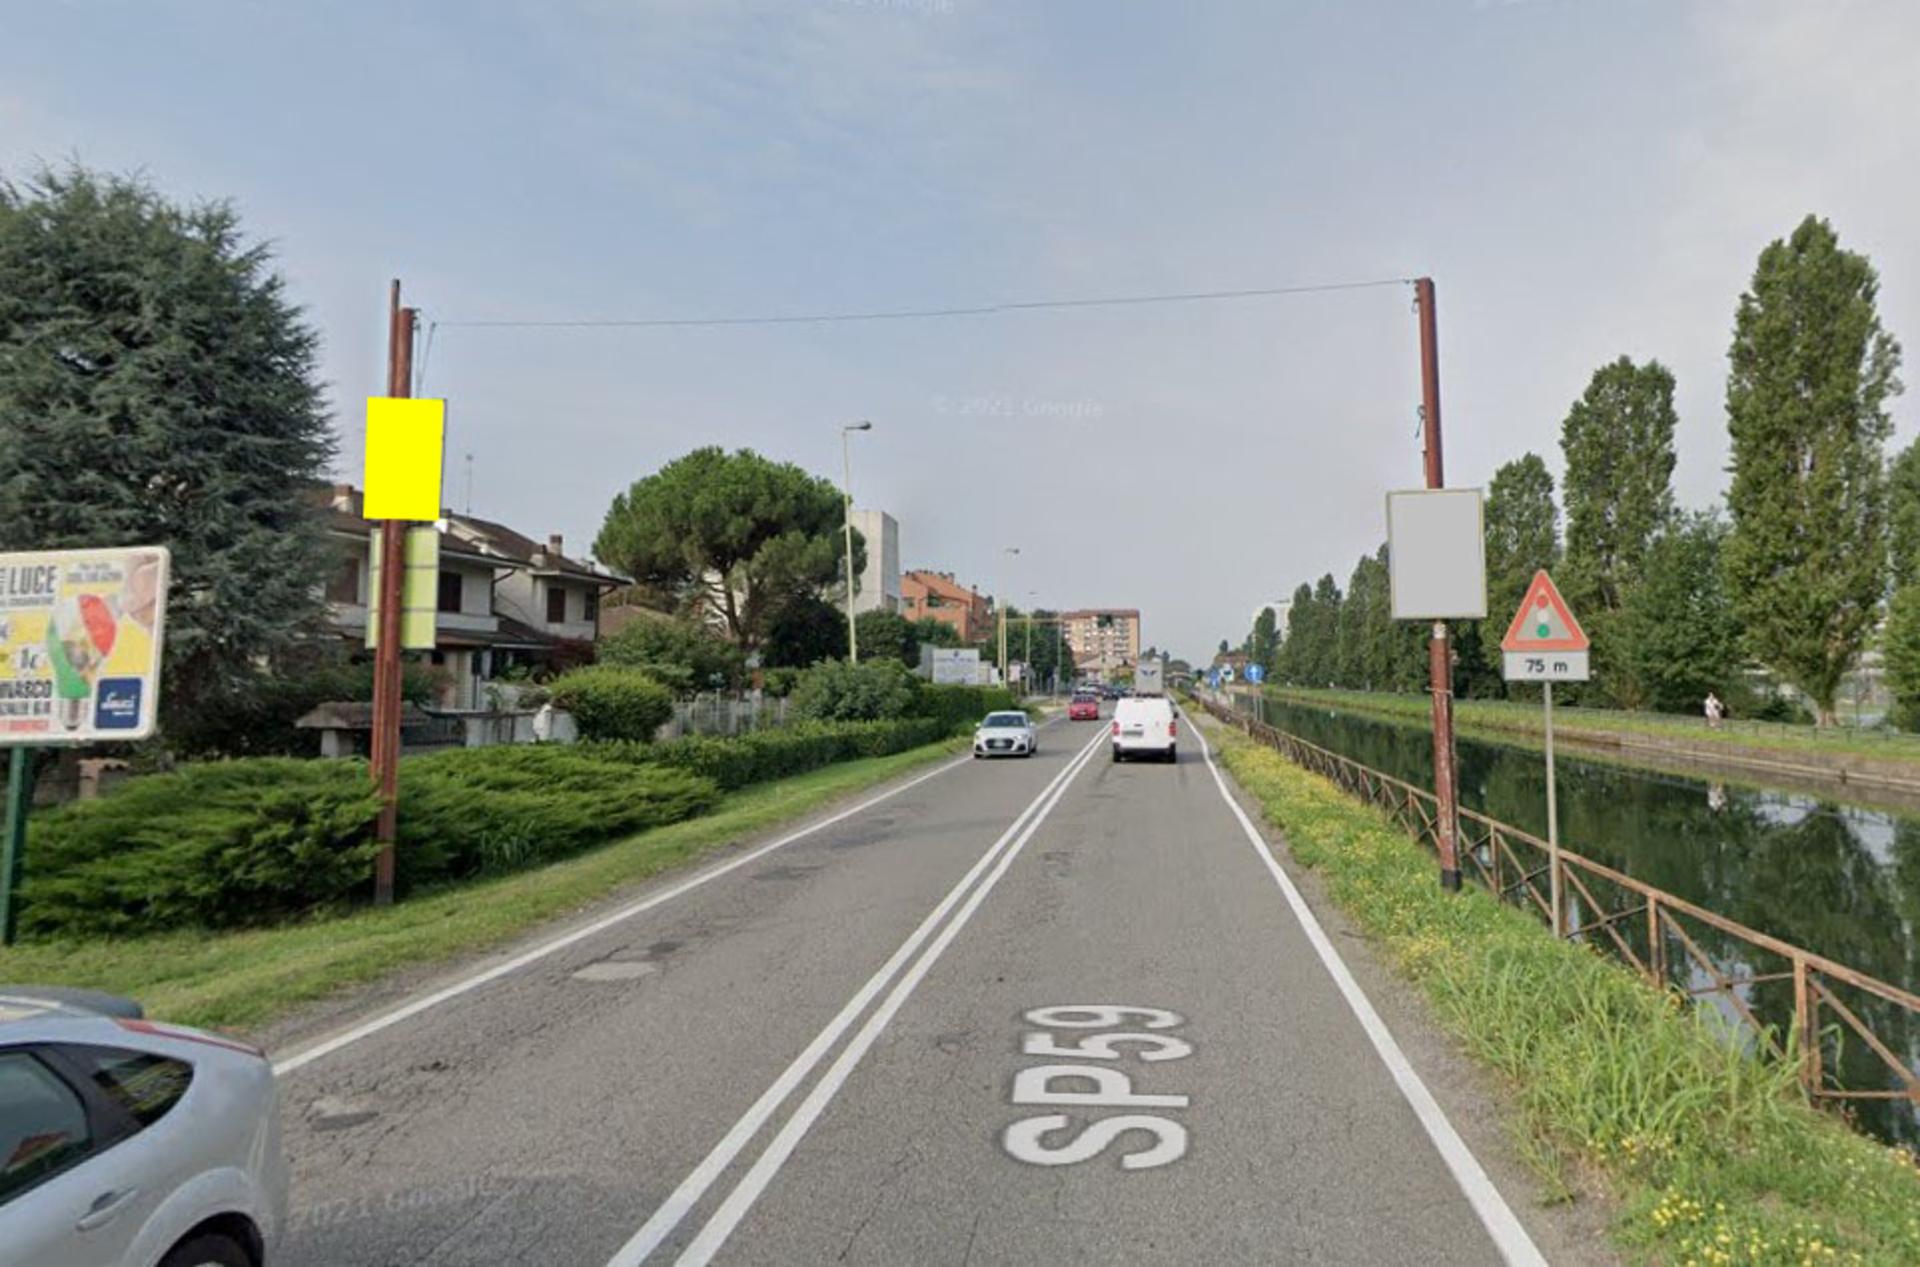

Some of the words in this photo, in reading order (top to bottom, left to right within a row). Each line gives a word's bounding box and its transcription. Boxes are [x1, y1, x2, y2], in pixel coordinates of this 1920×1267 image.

[9, 565, 57, 594] LUCE
[1525, 659, 1545, 673] 75
[1554, 661, 1568, 673] m
[1003, 1005, 1192, 1170] SP59
